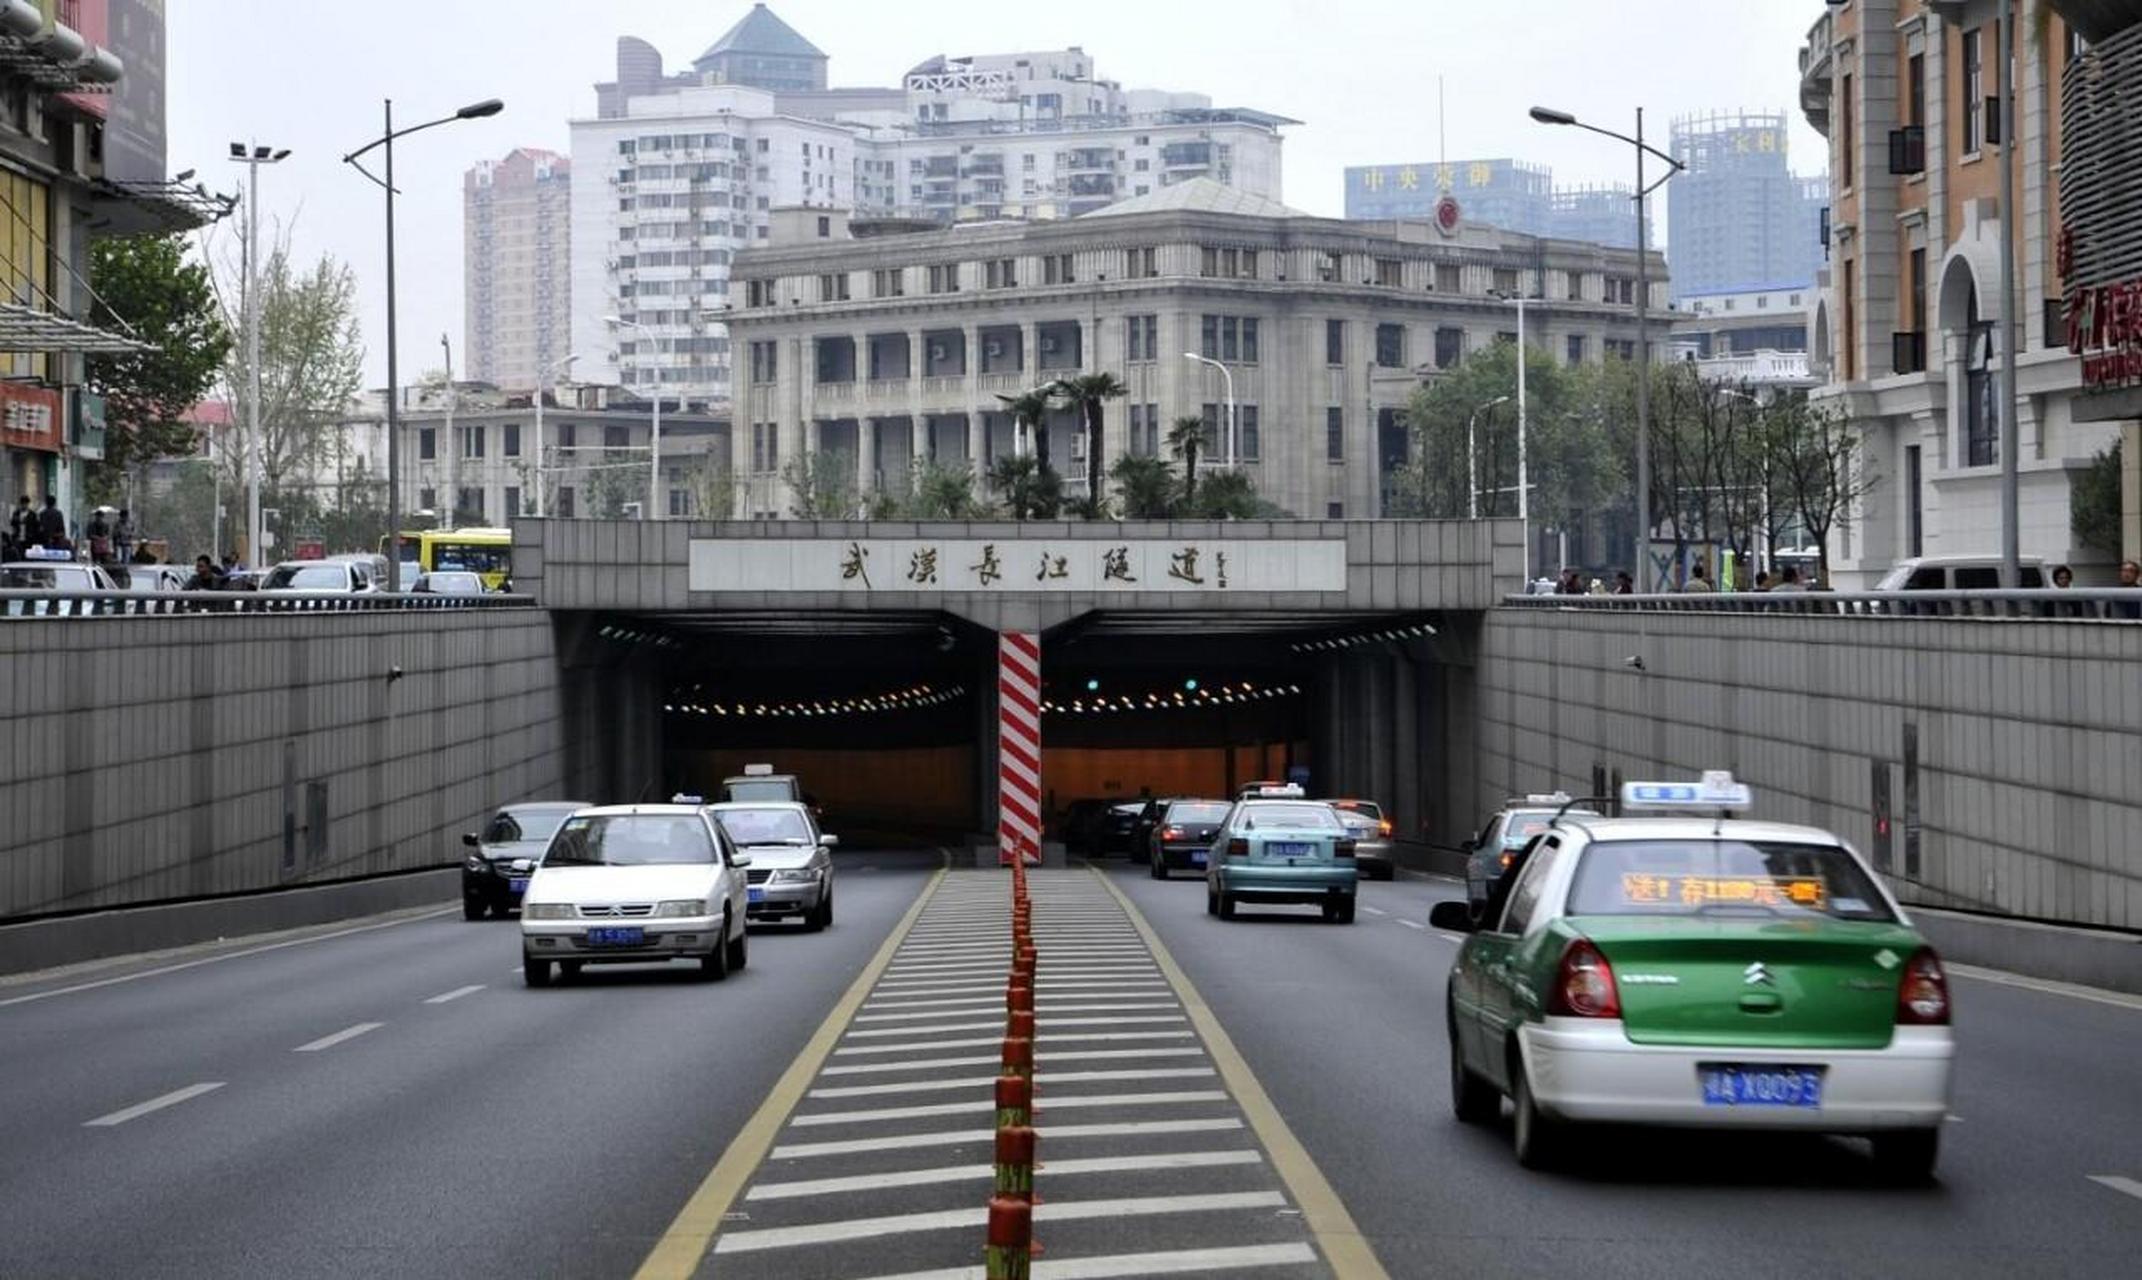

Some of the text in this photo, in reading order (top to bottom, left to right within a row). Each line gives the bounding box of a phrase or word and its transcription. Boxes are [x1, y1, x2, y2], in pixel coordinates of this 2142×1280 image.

[841, 543, 1204, 588] 武漢長江隧道
